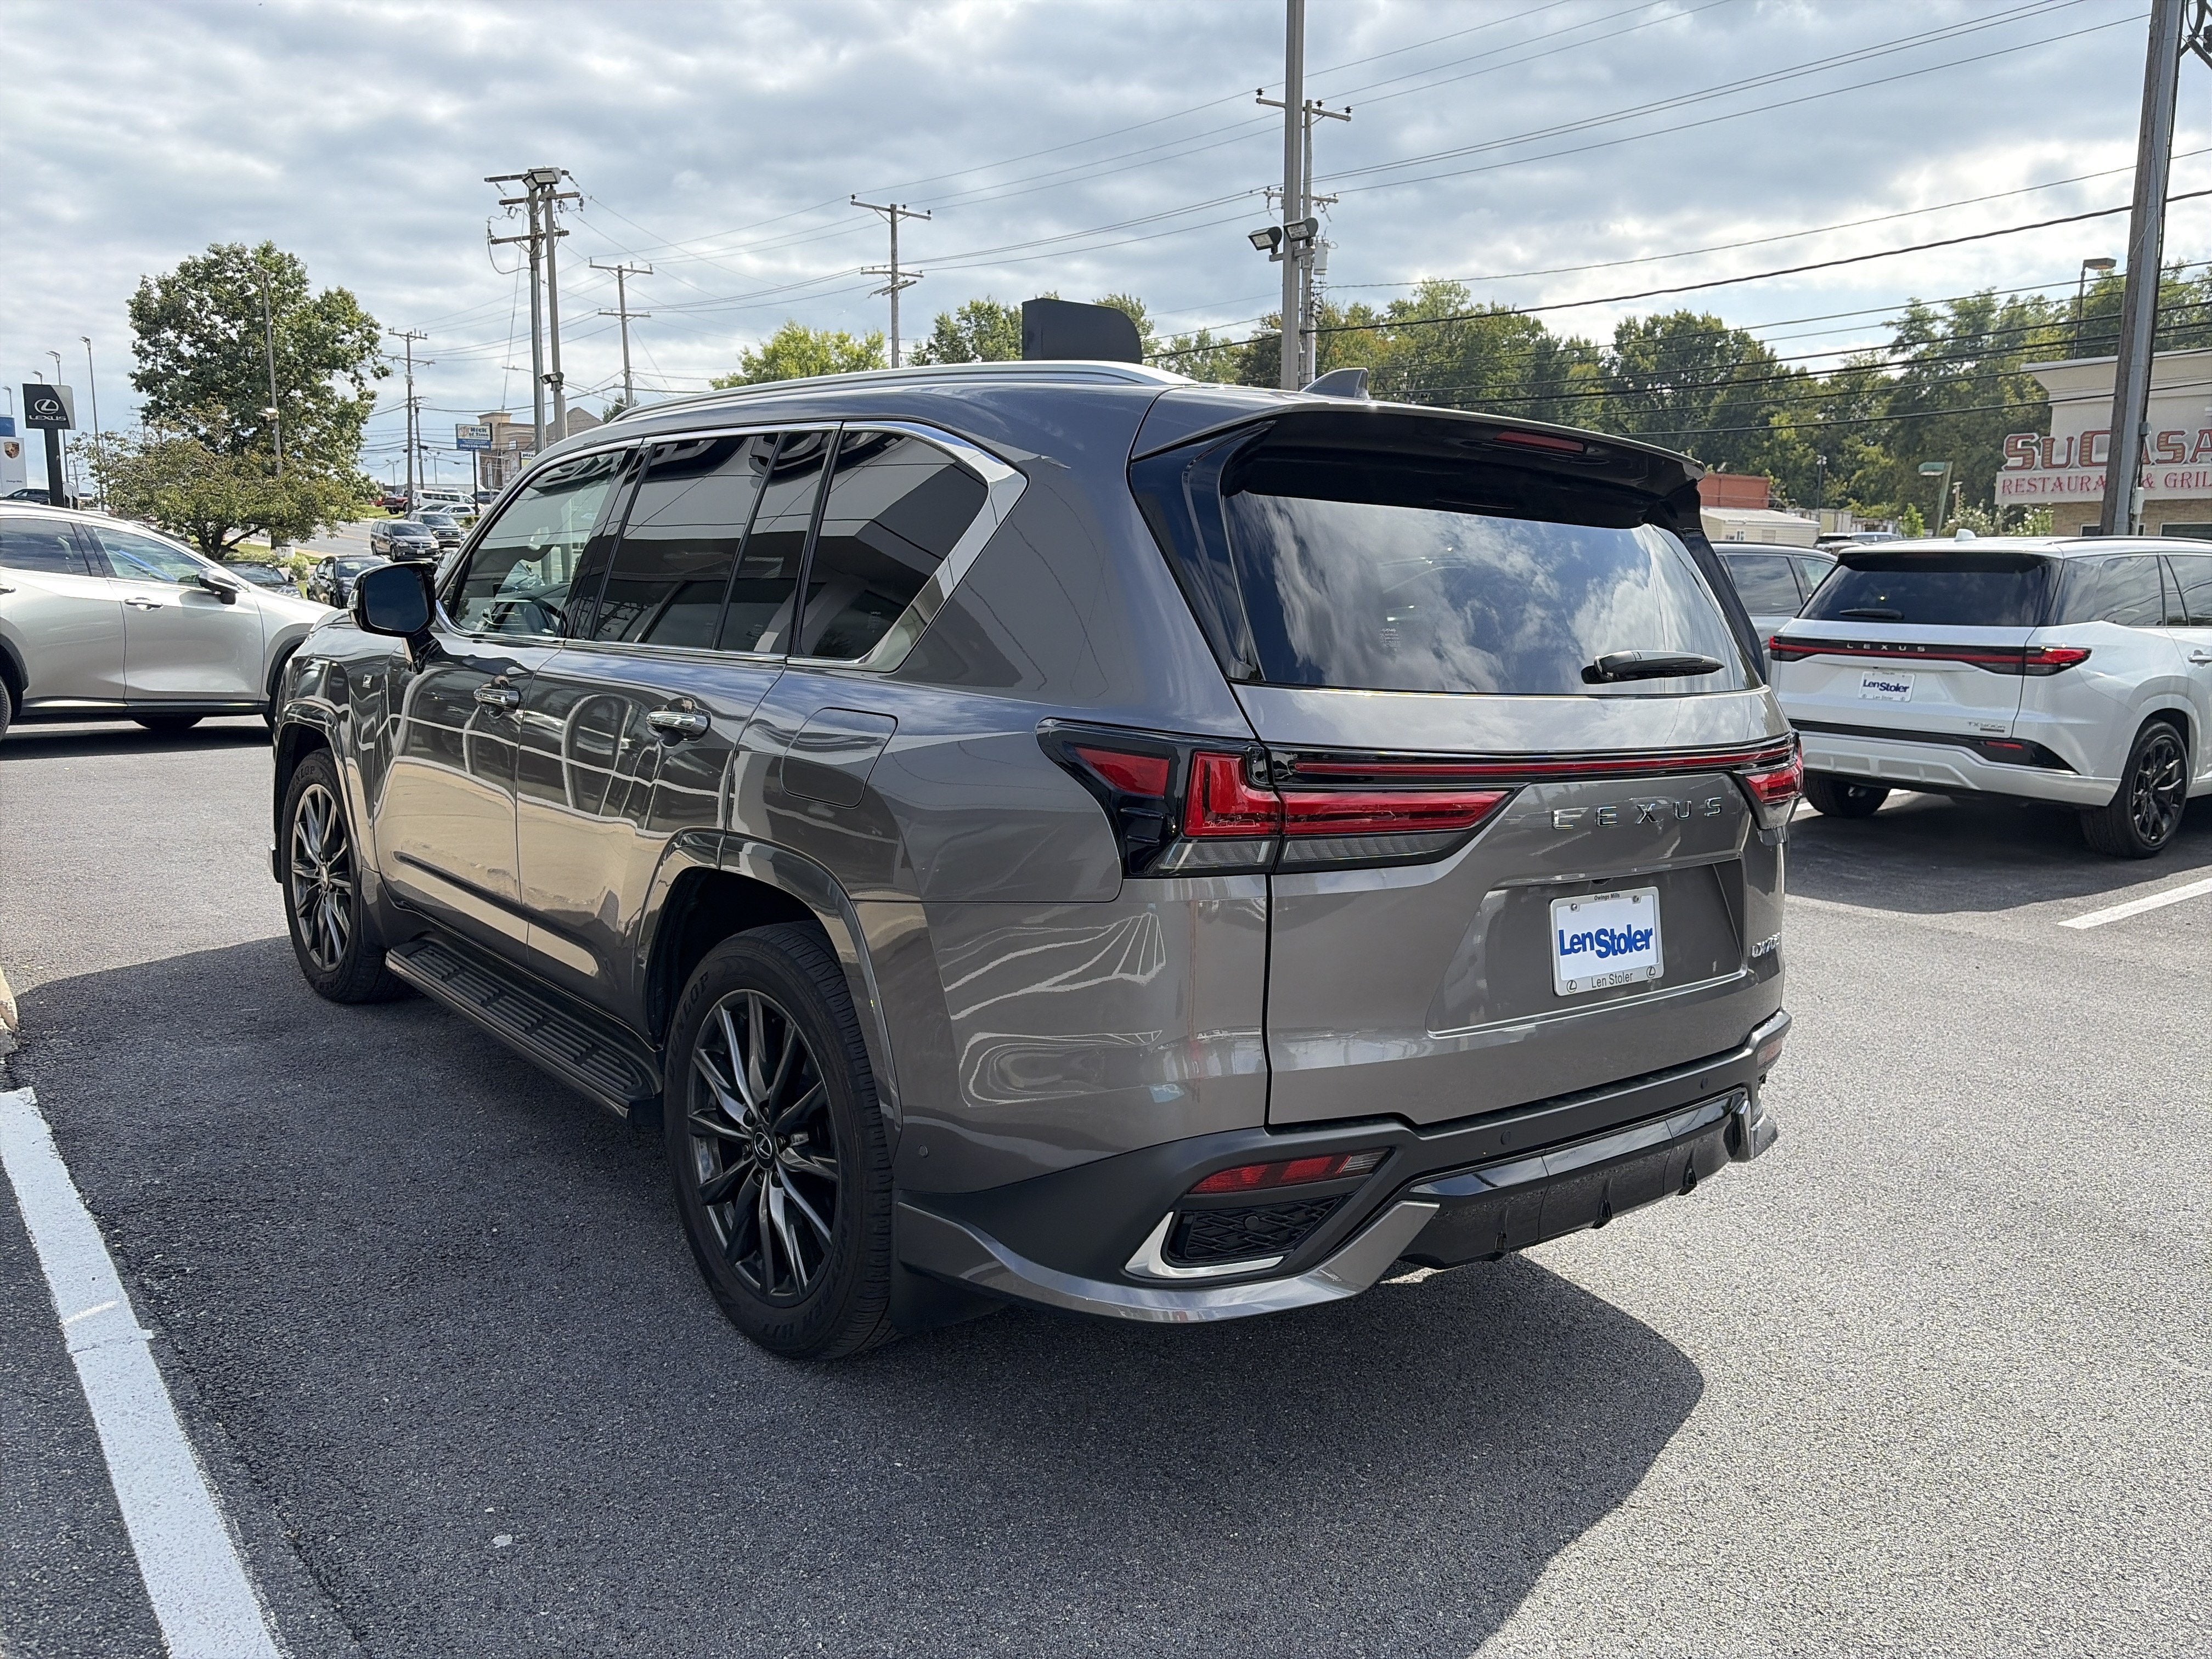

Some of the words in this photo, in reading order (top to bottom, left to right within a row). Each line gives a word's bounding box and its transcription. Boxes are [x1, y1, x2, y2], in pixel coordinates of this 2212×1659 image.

[2140, 472, 2155, 489] &
[1847, 642, 1926, 652] LEXUS
[1551, 797, 1722, 830] LEXUS
[1592, 977, 1607, 989] Len
[1609, 972, 1633, 985] Stoler
